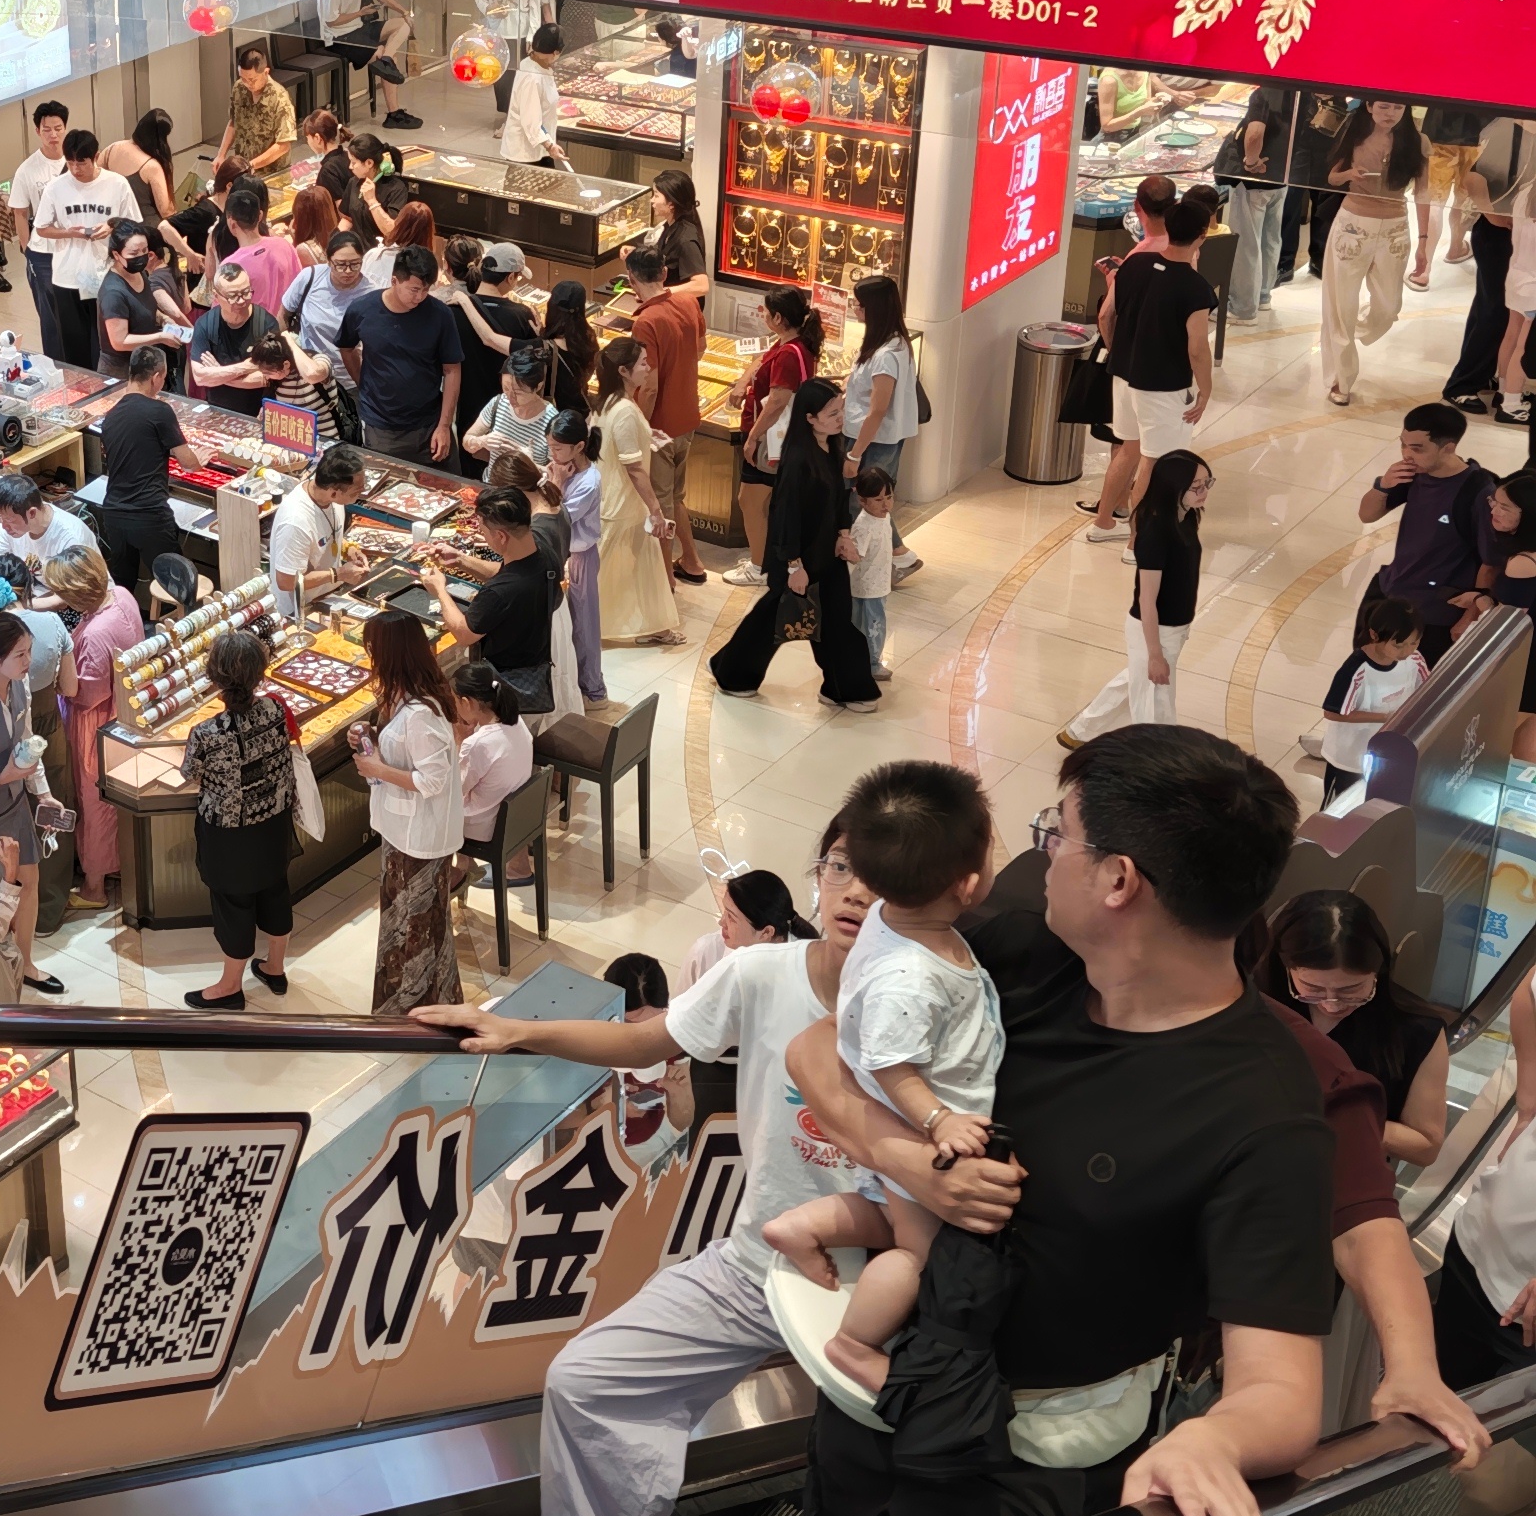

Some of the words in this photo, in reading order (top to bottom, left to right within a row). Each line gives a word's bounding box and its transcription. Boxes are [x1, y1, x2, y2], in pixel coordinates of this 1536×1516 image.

[264, 407, 314, 447] 高价回收黄金
